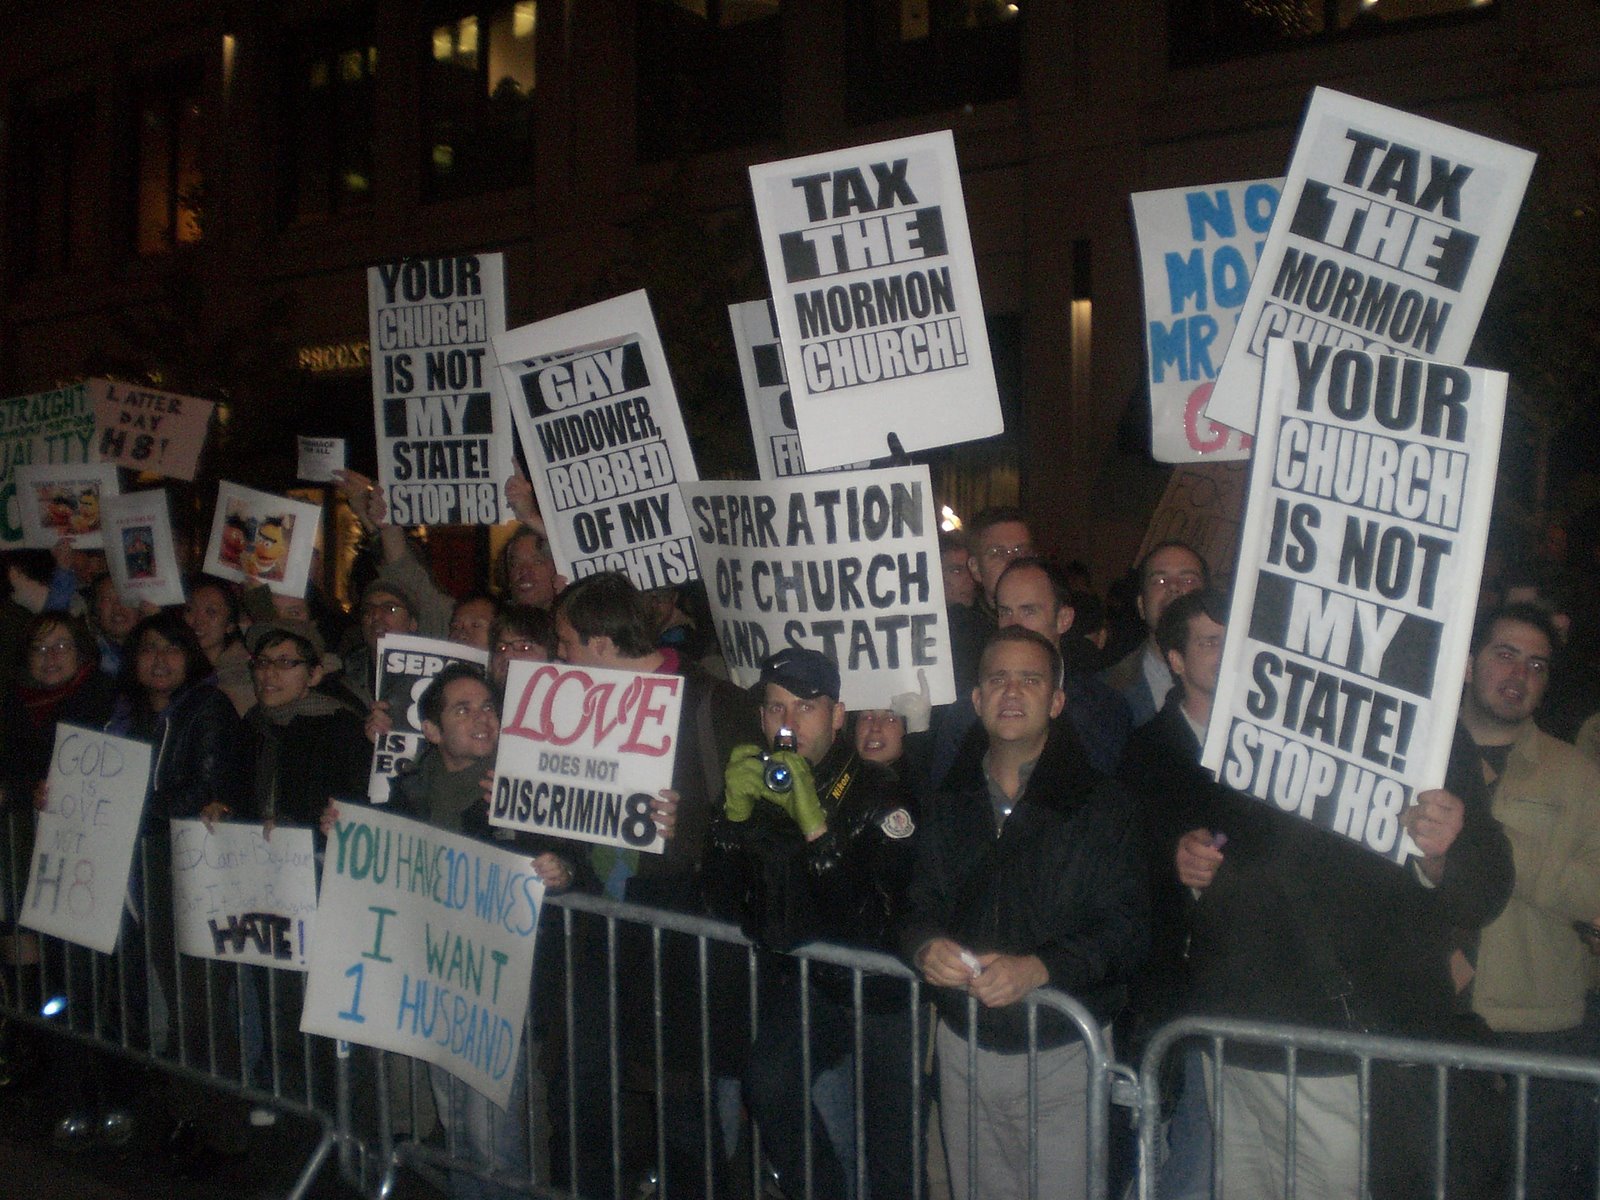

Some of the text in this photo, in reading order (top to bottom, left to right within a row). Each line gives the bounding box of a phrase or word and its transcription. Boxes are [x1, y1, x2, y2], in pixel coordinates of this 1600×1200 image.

[792, 158, 919, 223] TAX
[1343, 128, 1474, 221] TAX
[802, 211, 925, 277] THE
[1186, 183, 1281, 242] NO
[1320, 191, 1453, 282] THE
[378, 255, 481, 304] YOUR
[793, 265, 956, 340] MORMON
[1271, 246, 1453, 355] MORMON
[379, 300, 486, 350] CHURCH
[802, 317, 968, 394] CHURCH!
[106, 384, 182, 415] LATTER
[384, 353, 414, 394] IS
[426, 348, 486, 392] NOT
[538, 345, 625, 412] GAY
[1293, 342, 1471, 443] YOUR
[120, 411, 162, 431] DAY
[406, 394, 470, 437] MY
[535, 396, 661, 464] WIDOWER,
[392, 438, 490, 481] STATE!
[548, 441, 674, 510] ROBBED
[1275, 417, 1467, 532] CHURCH
[390, 483, 497, 525] STOP H8
[572, 493, 673, 554] OF MY
[692, 481, 924, 548] SEPARATION
[716, 551, 929, 613] OF CHURCH
[1266, 497, 1321, 574] IS
[1338, 513, 1452, 609] NOT
[721, 619, 770, 669] AND
[1285, 581, 1408, 680] MY
[377, 733, 406, 753] IS
[501, 665, 680, 757] LOVE
[1246, 650, 1419, 775] STATE!
[58, 734, 124, 777] GOD
[538, 752, 620, 782] DOES NOT
[1226, 719, 1404, 855] STOP H8
[493, 776, 657, 847] DISCRIMIN8
[31, 853, 95, 920] H8
[334, 820, 544, 937] YOU HAVE 10 WIVES
[361, 906, 509, 1005] I WANT
[337, 962, 514, 1081] 1 HUSBAND
